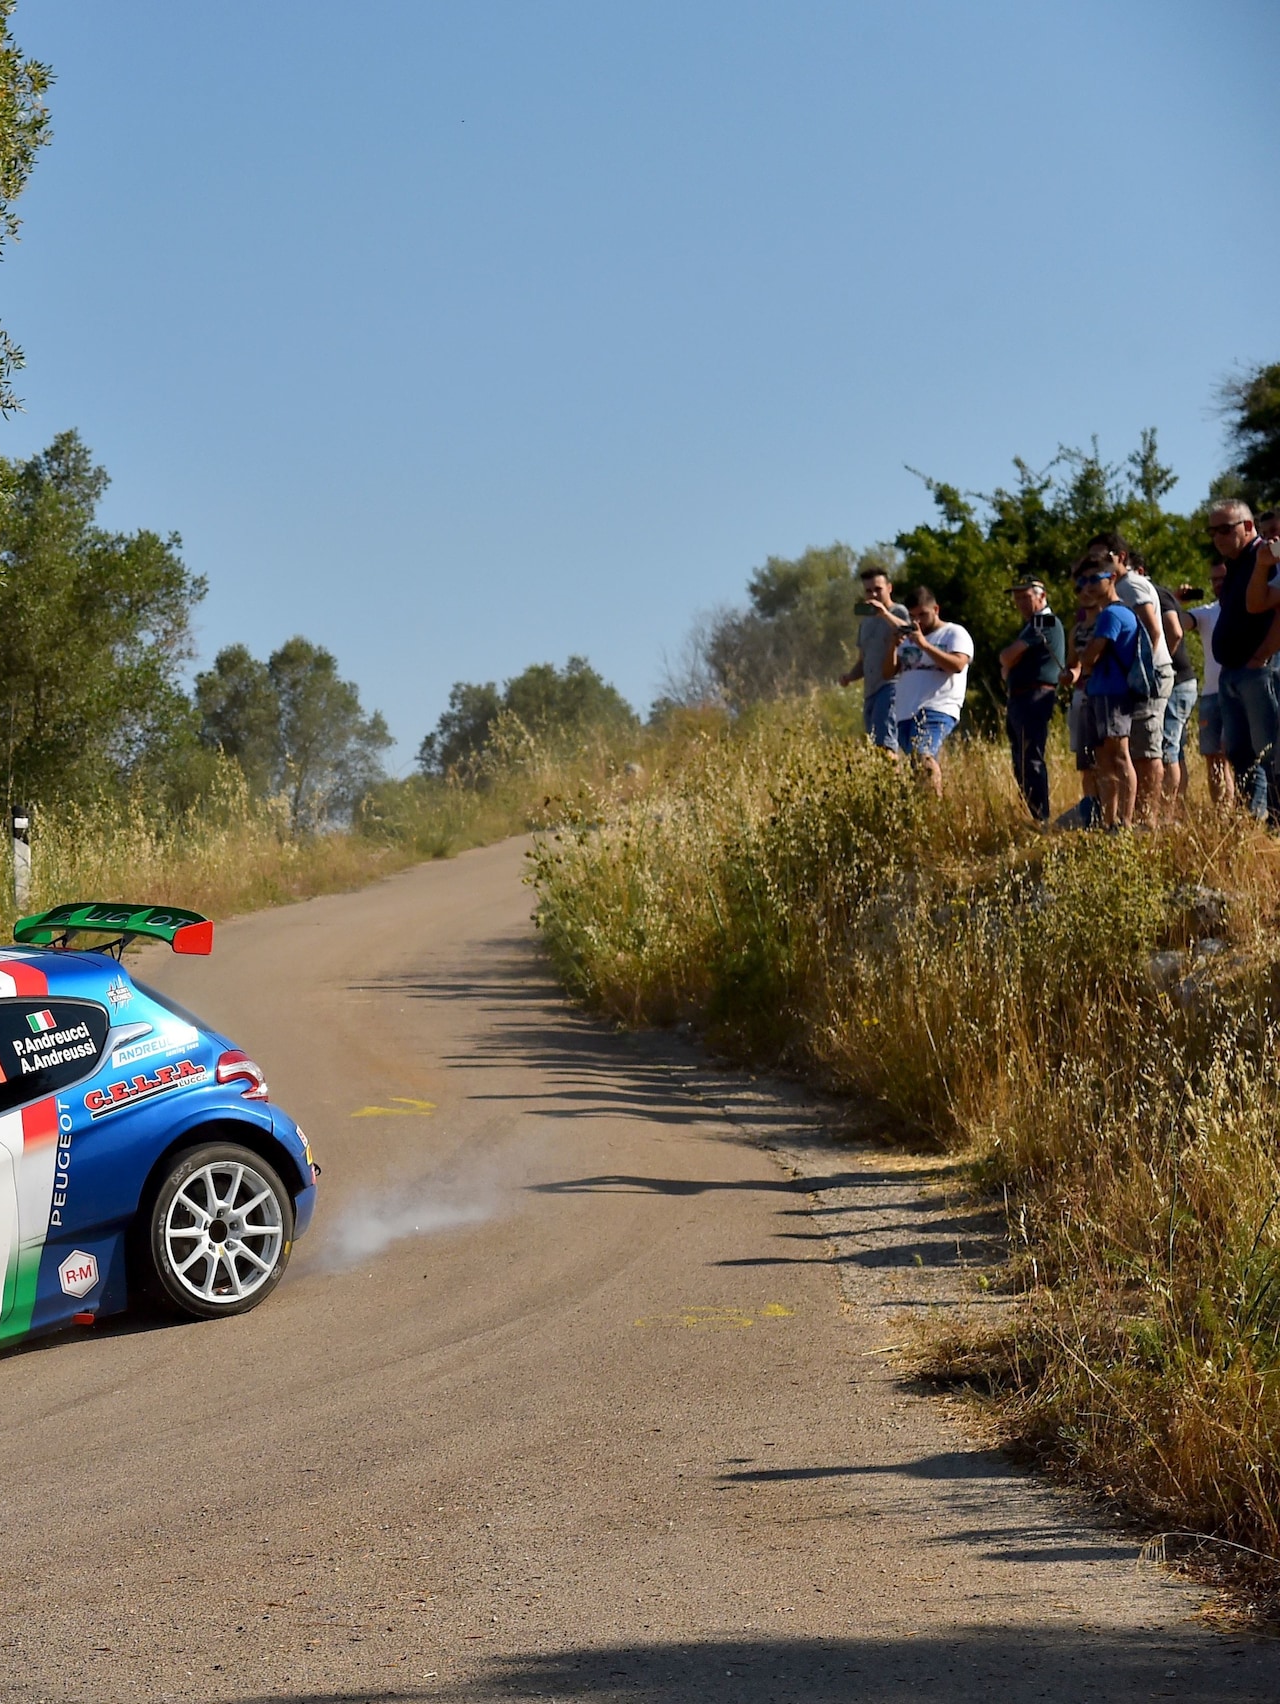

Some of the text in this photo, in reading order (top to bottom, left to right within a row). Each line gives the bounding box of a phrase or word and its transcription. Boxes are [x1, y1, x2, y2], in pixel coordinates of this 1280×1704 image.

[48, 910, 196, 930] PUGOT
[13, 1022, 91, 1056] P.Andreucci
[21, 1039, 98, 1074] A.Andreussi
[179, 1074, 207, 1087] LUCCA
[51, 1098, 72, 1226] PEUGEOT
[65, 1264, 93, 1285] R-M
